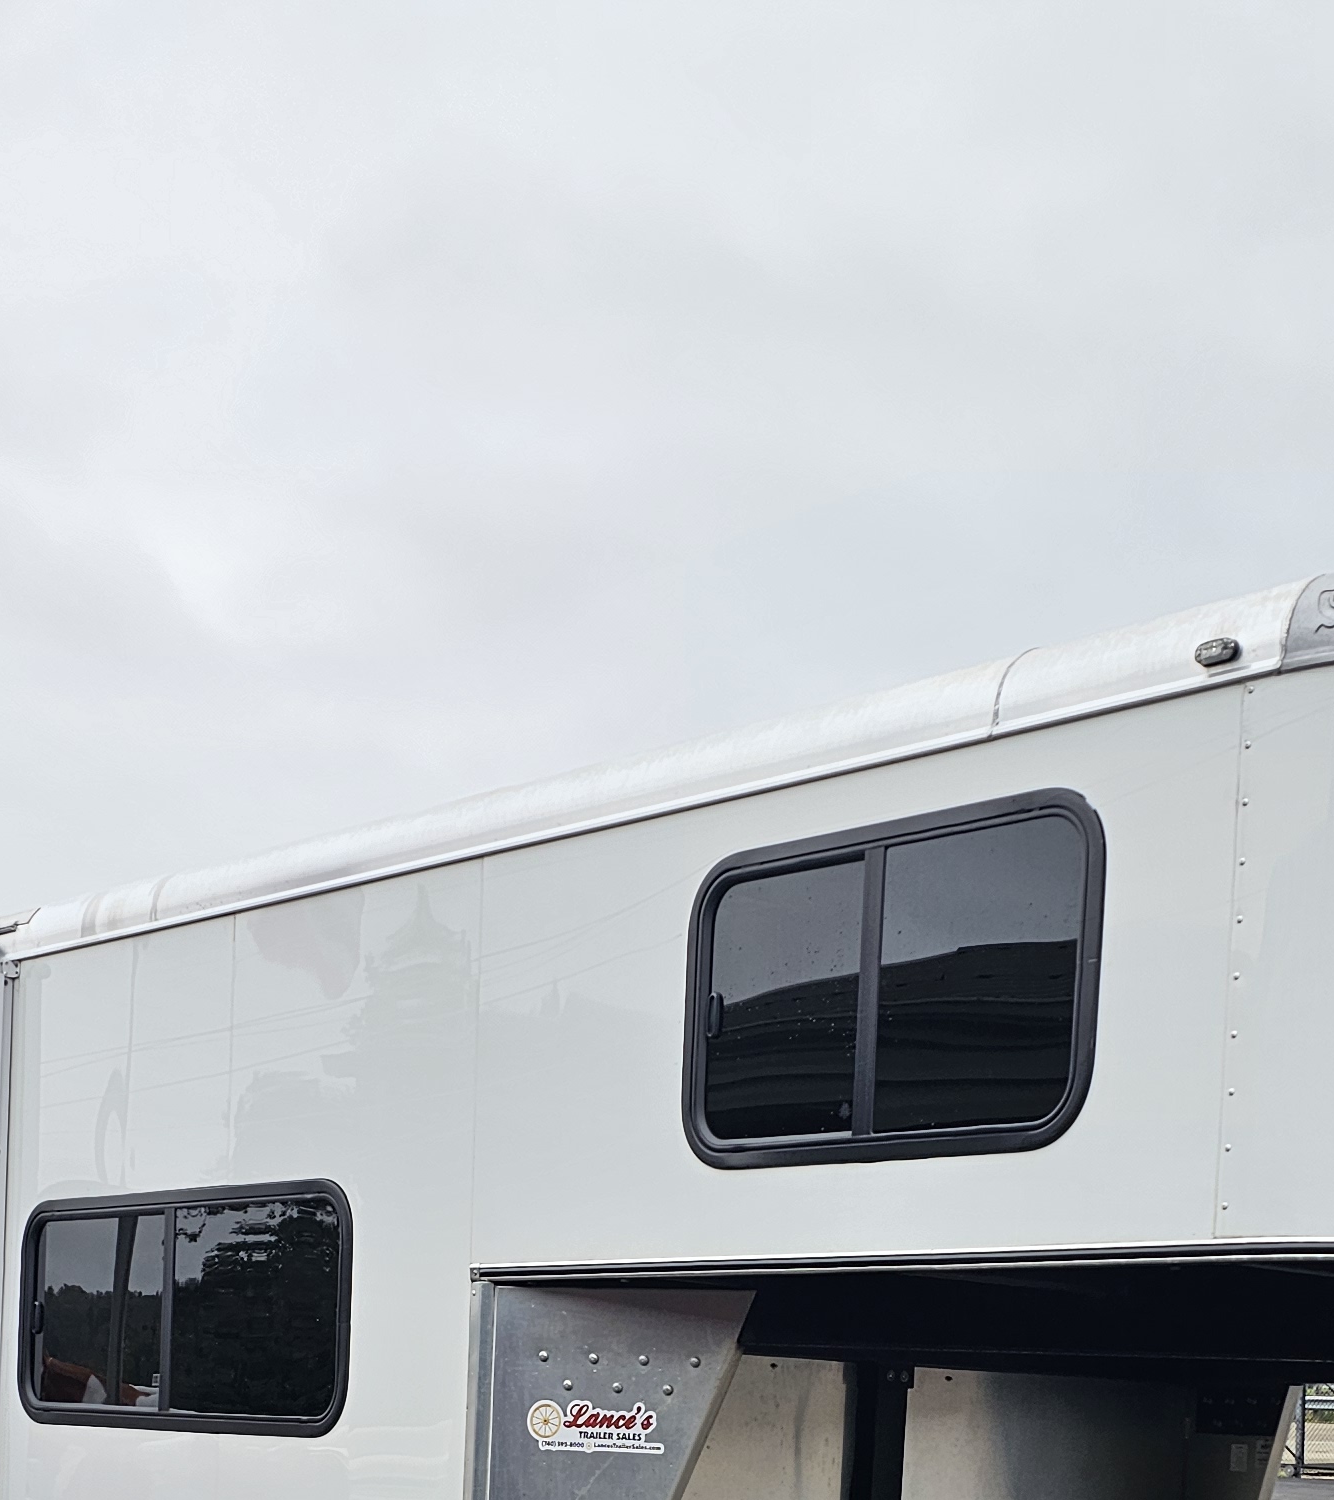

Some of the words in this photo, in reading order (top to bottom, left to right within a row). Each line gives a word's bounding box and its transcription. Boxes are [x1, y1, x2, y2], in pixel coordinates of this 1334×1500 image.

[562, 1403, 654, 1431] Lance's
[578, 1430, 614, 1441] TRAILER
[616, 1432, 643, 1442] SALES
